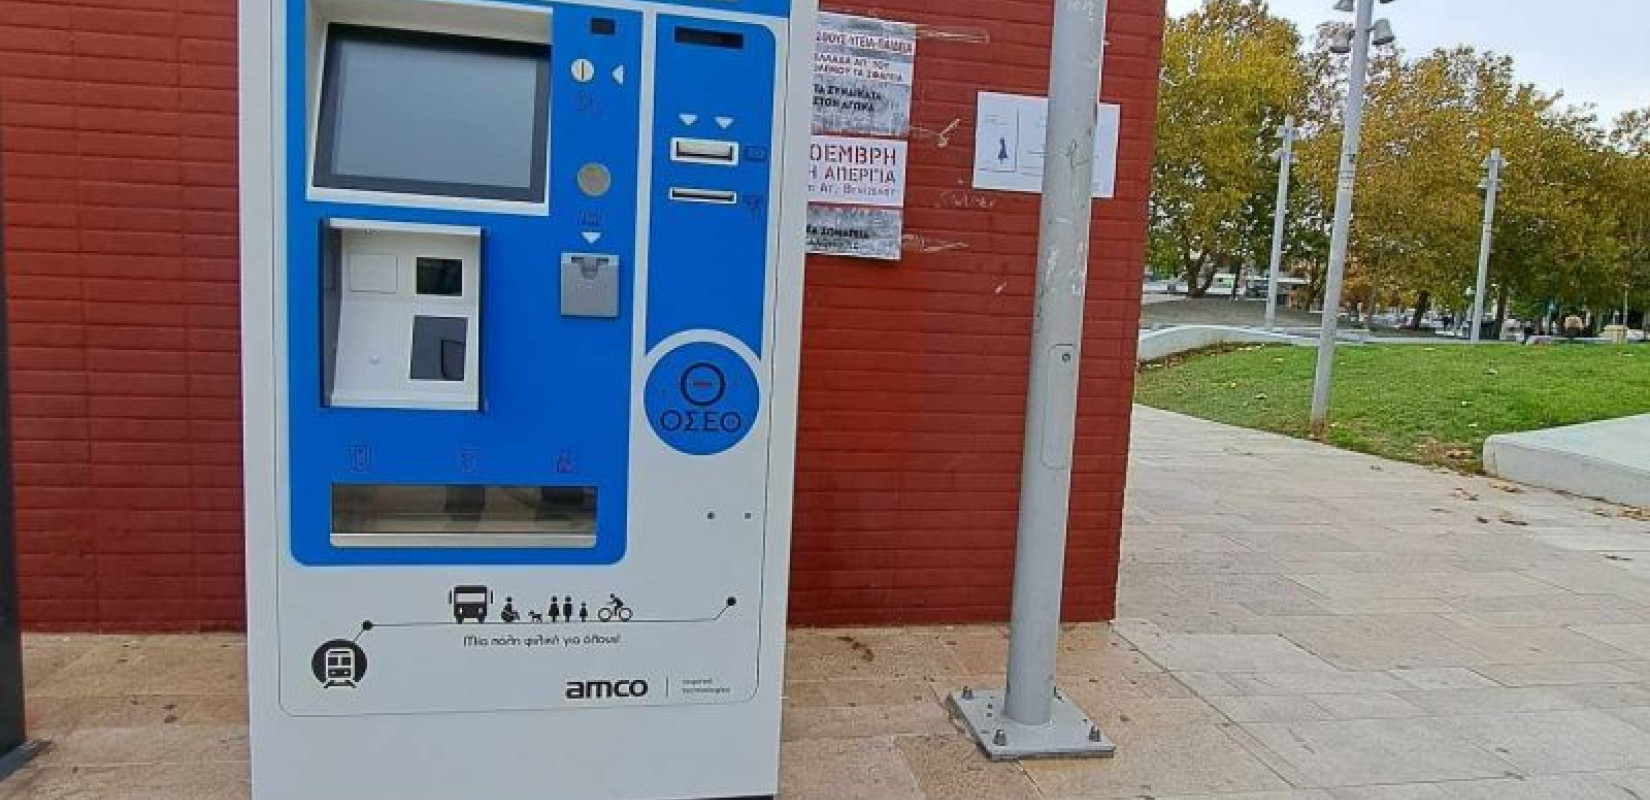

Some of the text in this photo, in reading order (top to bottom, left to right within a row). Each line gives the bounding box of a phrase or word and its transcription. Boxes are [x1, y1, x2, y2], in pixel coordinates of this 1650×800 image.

[810, 144, 895, 165] ΟΕΜΒΡΗ
[824, 166, 895, 183] ΑΠΕΡΓΙΑ
[660, 409, 742, 433] ΟΣΕΘ
[566, 679, 648, 699] amco
